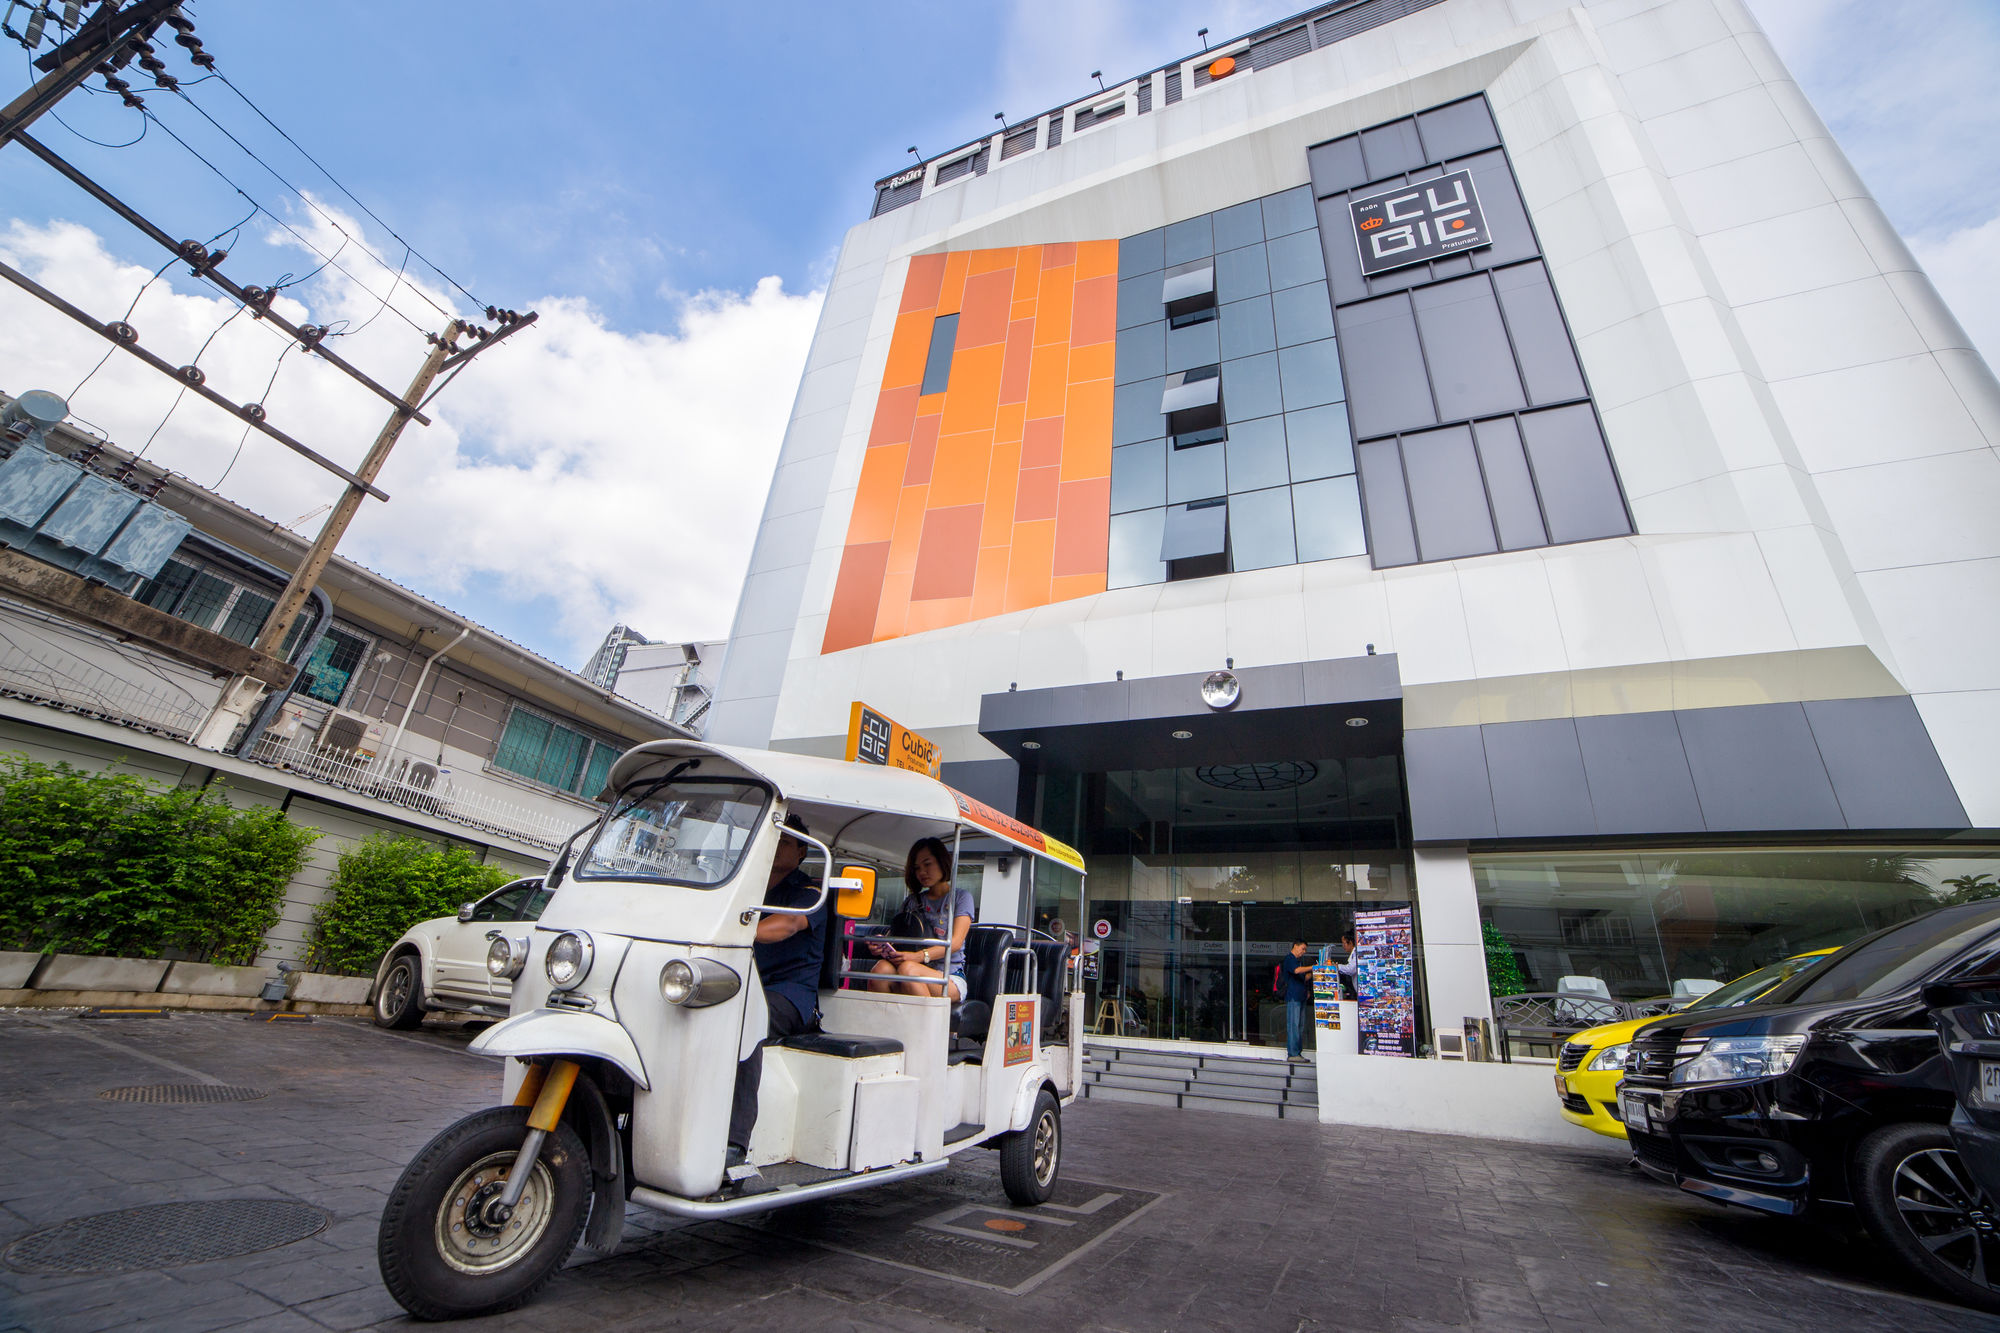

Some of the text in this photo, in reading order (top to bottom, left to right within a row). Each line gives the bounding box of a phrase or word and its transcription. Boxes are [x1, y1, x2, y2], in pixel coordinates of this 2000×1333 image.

[919, 38, 1254, 200] CUBIC
[1384, 180, 1468, 224] CU
[1369, 208, 1477, 259] BIC
[1441, 236, 1480, 250] Pratunam
[901, 731, 933, 764] Cubic
[904, 1228, 1021, 1258] Pratunam
